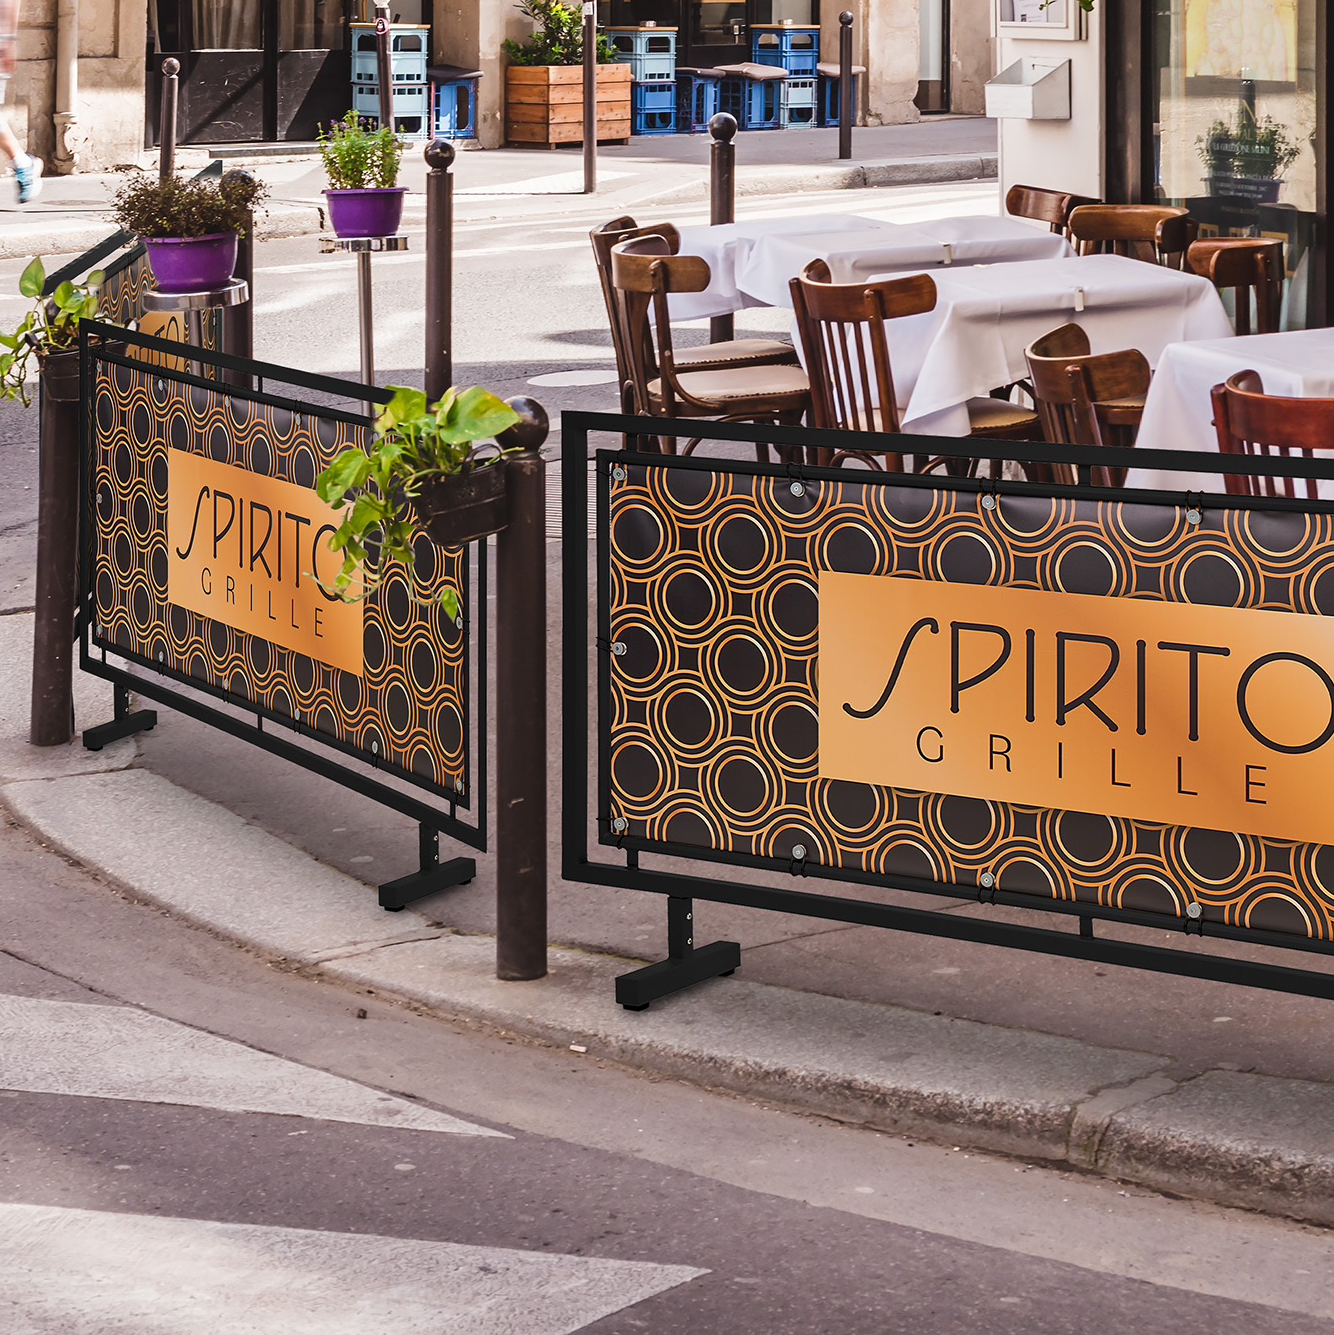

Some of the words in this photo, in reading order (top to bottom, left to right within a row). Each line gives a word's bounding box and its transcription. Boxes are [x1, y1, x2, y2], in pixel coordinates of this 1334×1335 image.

[175, 485, 350, 603] SPIRITO
[201, 567, 324, 638] GRILLE
[915, 726, 1268, 805] GRILLE
